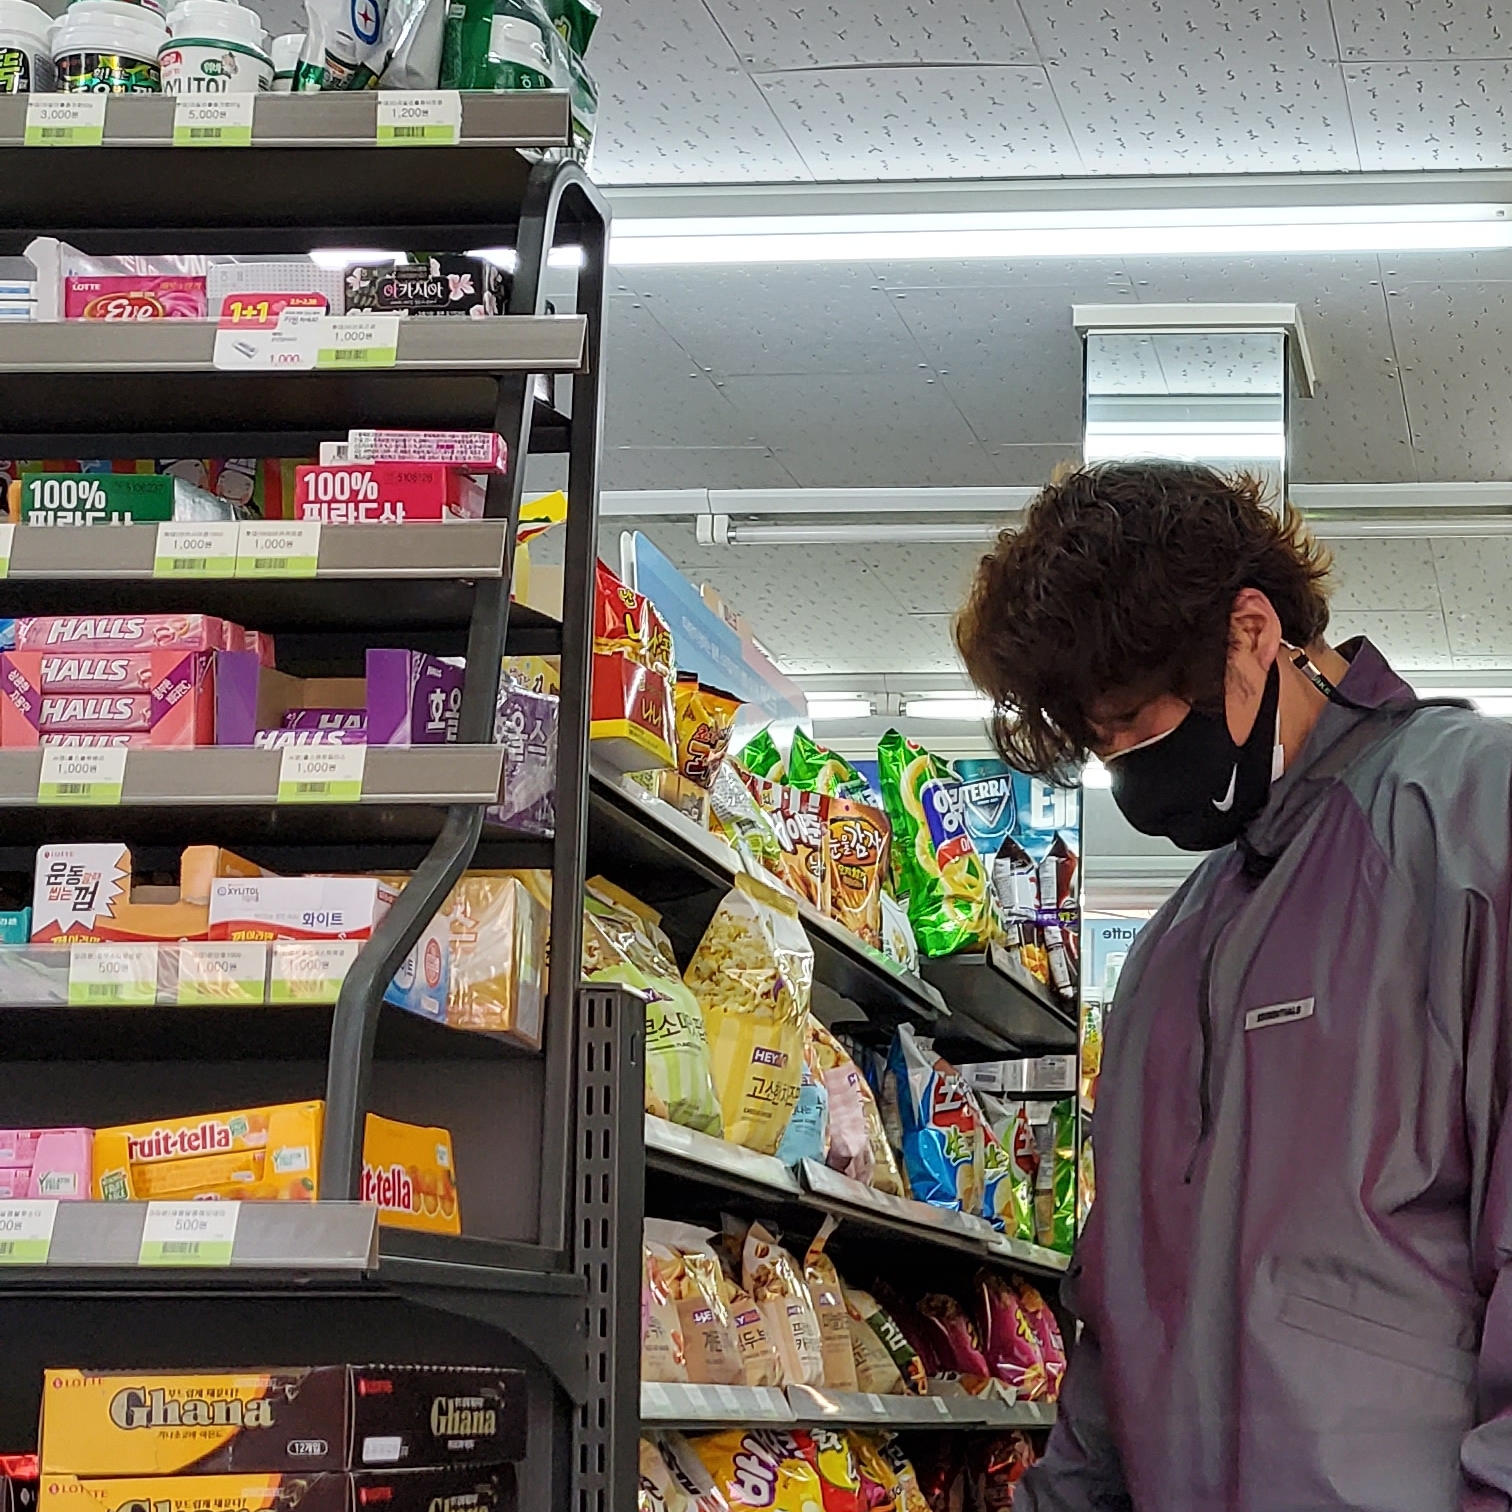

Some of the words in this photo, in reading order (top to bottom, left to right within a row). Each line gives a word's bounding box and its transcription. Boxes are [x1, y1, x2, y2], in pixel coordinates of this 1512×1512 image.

[40, 109, 78, 119] 3,000원
[189, 109, 227, 119] 5,000원
[392, 108, 429, 119] 1,200원
[72, 282, 100, 291] LOTTE
[383, 282, 443, 296] 아카시아
[106, 301, 153, 318] Eve
[230, 301, 269, 323] 1+1
[335, 331, 372, 341] 1,000원
[270, 354, 300, 365] 1,000
[303, 472, 378, 501] 100%
[30, 480, 106, 509] 100%
[173, 539, 212, 549] 1,000원
[254, 539, 293, 549] 1,000원
[46, 618, 147, 645] HALLS
[41, 659, 130, 682] HALLS
[40, 698, 135, 724] HALLS
[57, 763, 97, 774] 1,000원
[297, 762, 337, 773] 1,000원
[964, 781, 1010, 801] TERRA
[829, 822, 881, 858] 눈을감자
[46, 862, 84, 886] 운동
[72, 881, 99, 912] 껌
[227, 887, 259, 896] XYLITOL
[302, 912, 344, 927] 화이트
[98, 962, 129, 973] 500원
[0, 1220, 22, 1231] 00원
[174, 1220, 208, 1231] 500원
[109, 1386, 275, 1430] Ghana
[430, 1396, 496, 1437] Ghana
